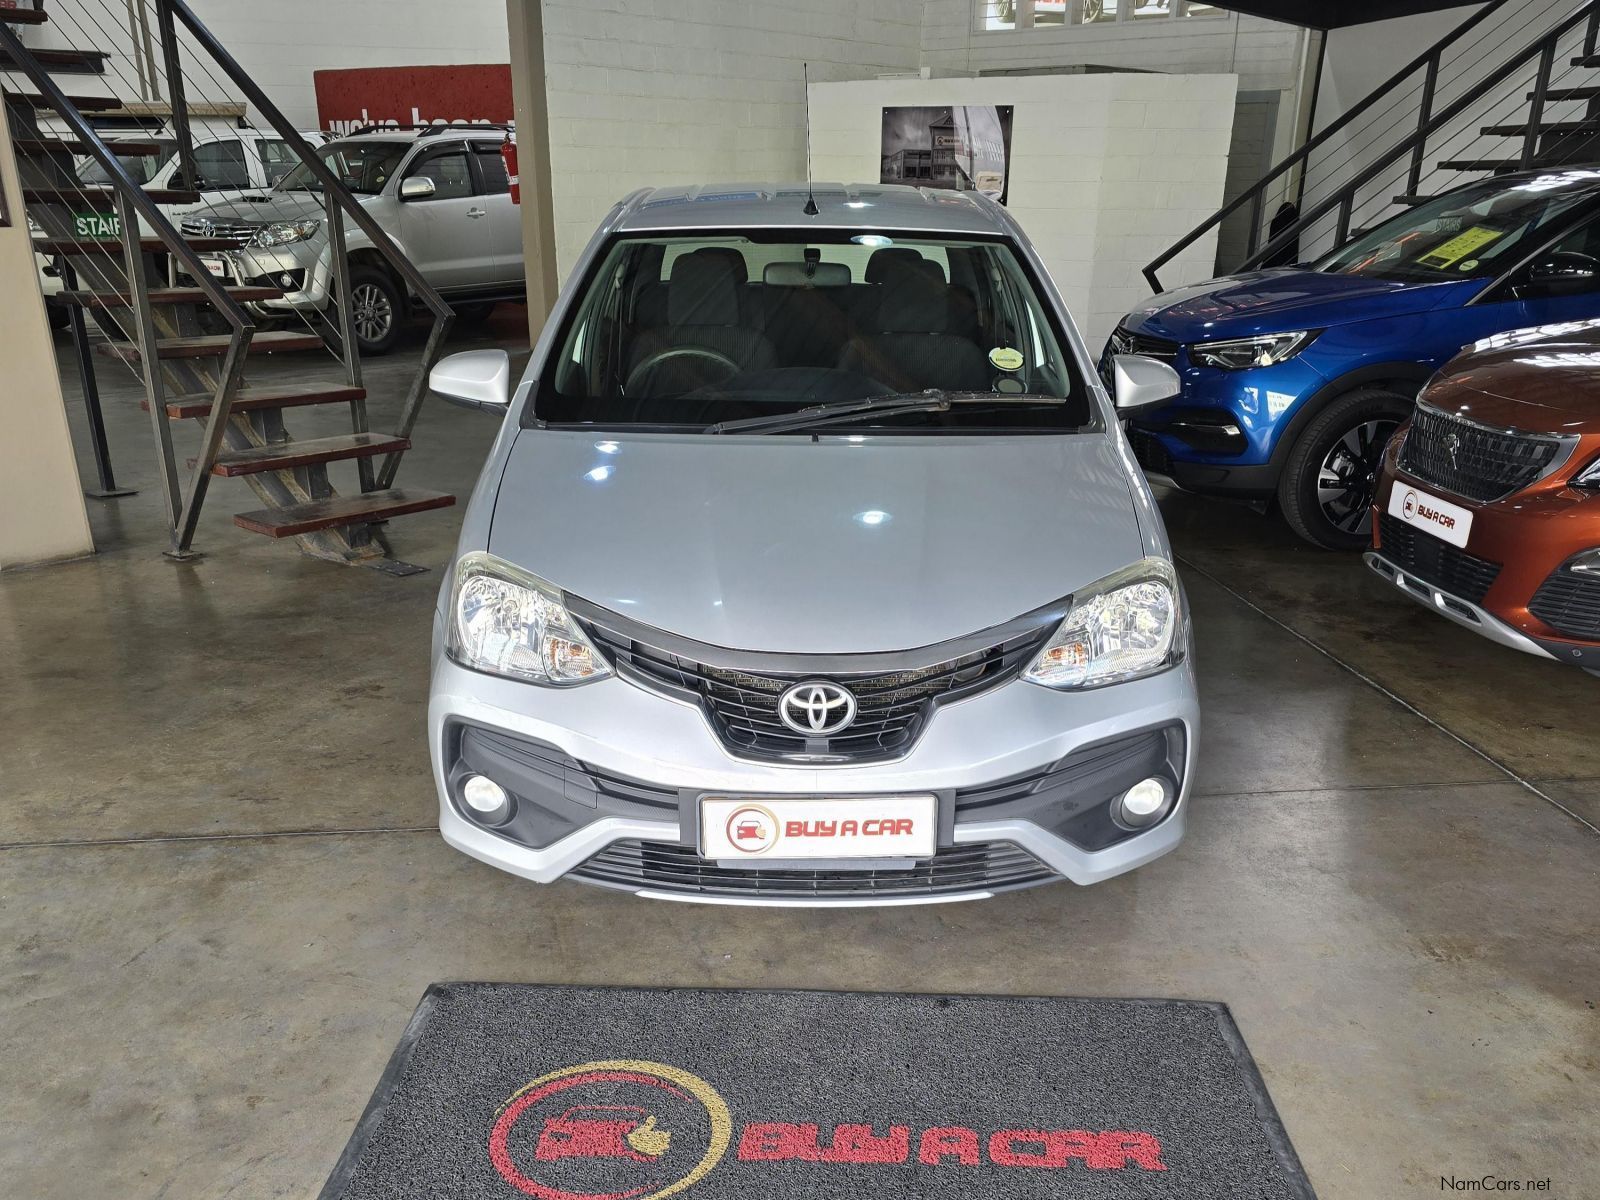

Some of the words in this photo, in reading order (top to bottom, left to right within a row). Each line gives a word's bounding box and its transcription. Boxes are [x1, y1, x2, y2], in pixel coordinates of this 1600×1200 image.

[1417, 505, 1434, 520] BUY
[1432, 512, 1440, 522] A
[1439, 514, 1456, 530] CAR
[785, 820, 837, 837] BUY
[840, 820, 858, 836] A
[862, 818, 914, 836] CAR
[737, 1122, 910, 1164] BUY
[918, 1125, 980, 1166] A
[988, 1128, 1168, 1171] CAR
